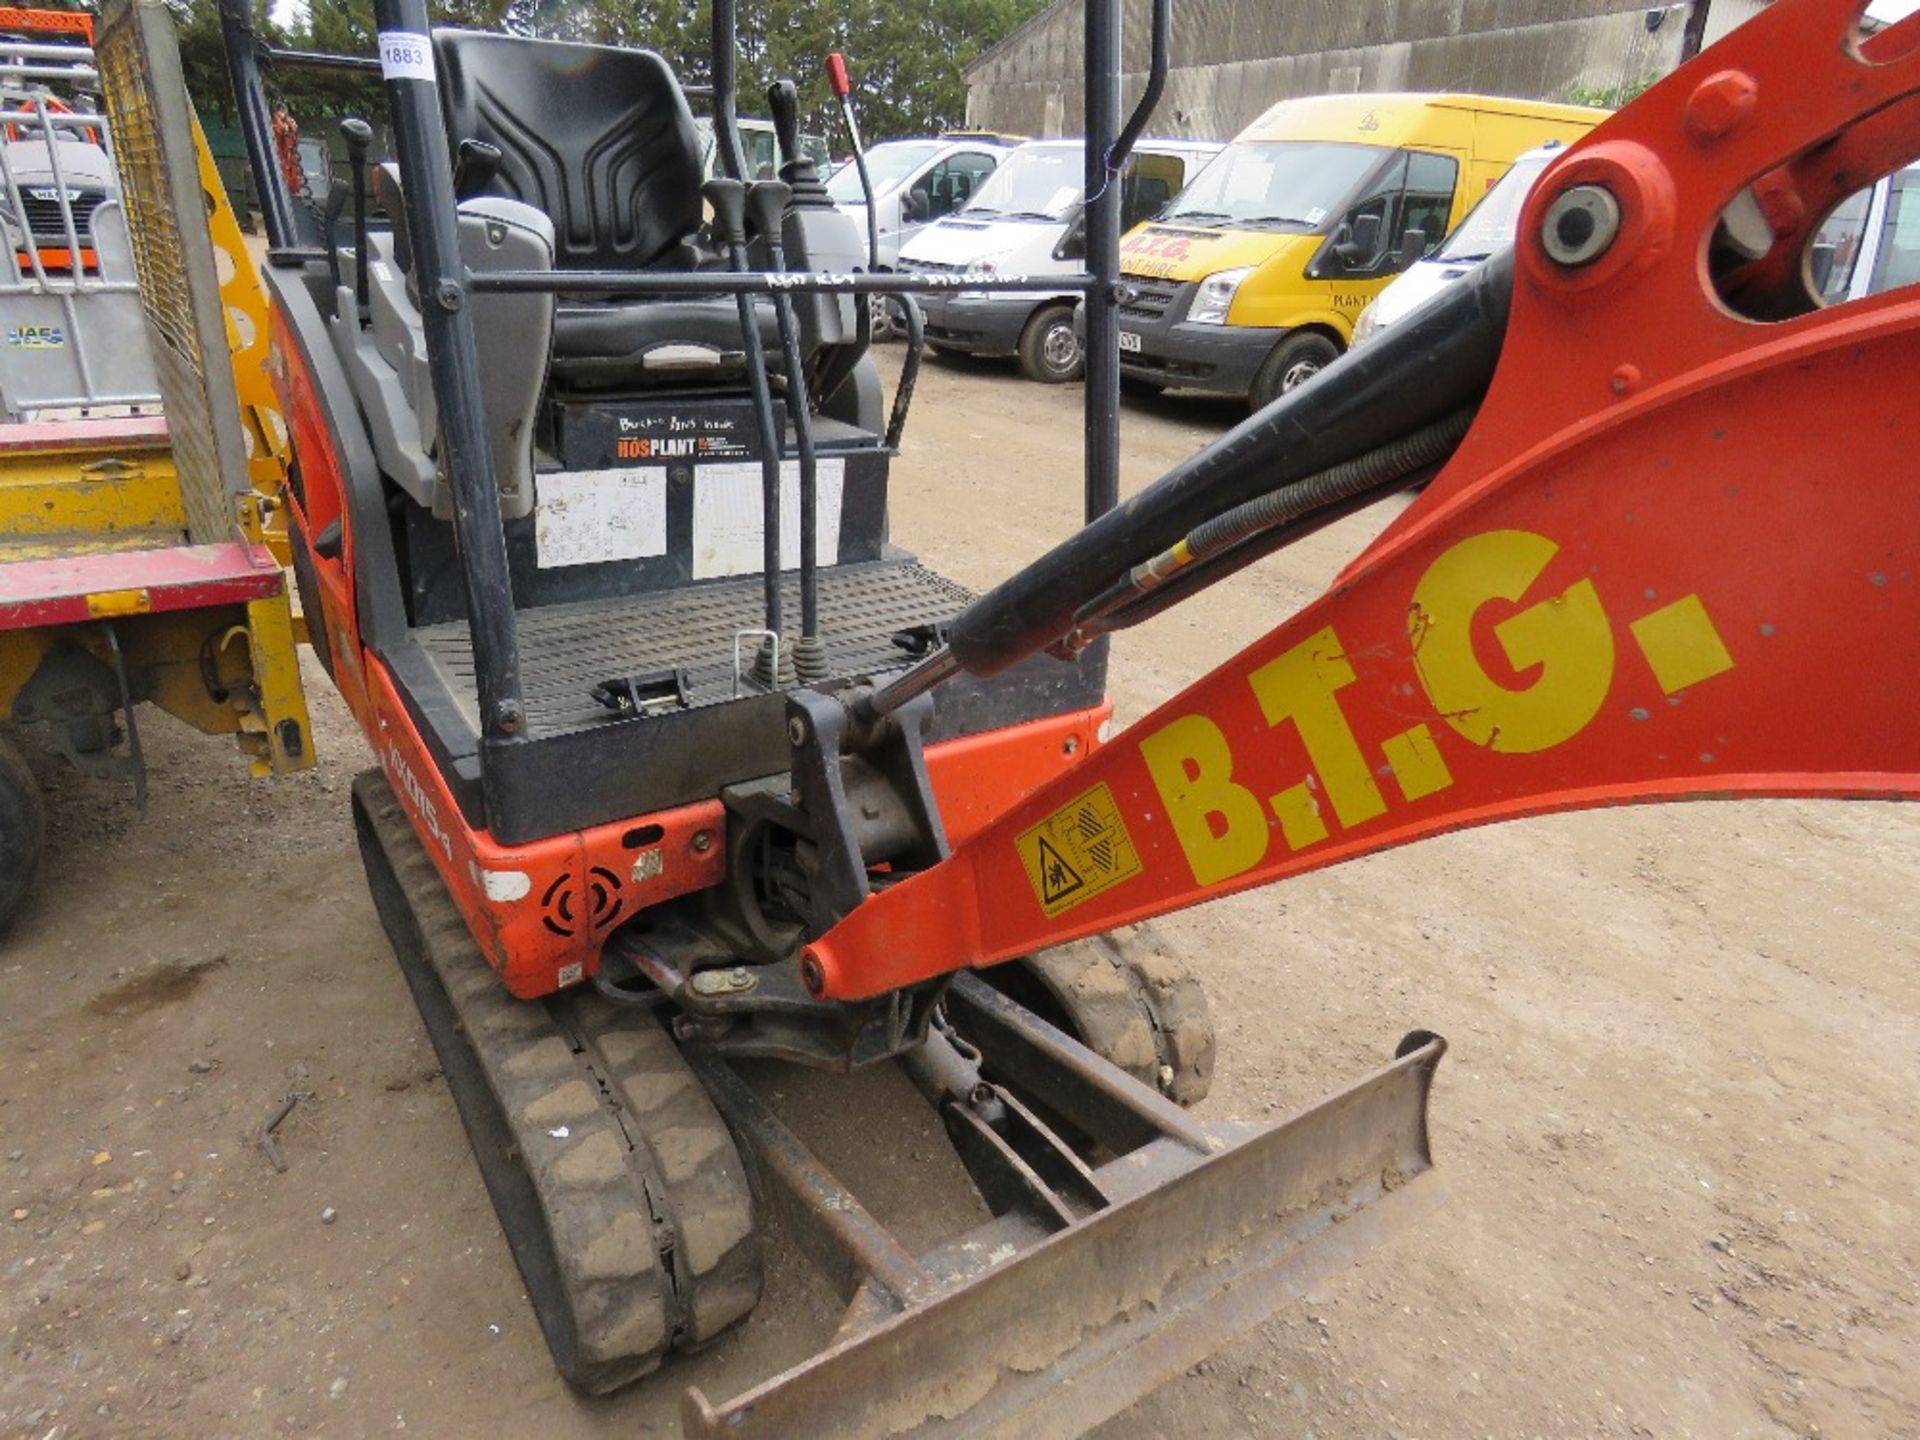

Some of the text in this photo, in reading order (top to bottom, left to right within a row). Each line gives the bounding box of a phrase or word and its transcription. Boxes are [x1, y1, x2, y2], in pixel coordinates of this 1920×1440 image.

[385, 47, 424, 66] 1883
[1333, 295, 1367, 308] PLANT
[1139, 529, 1736, 887] B.T.G.
